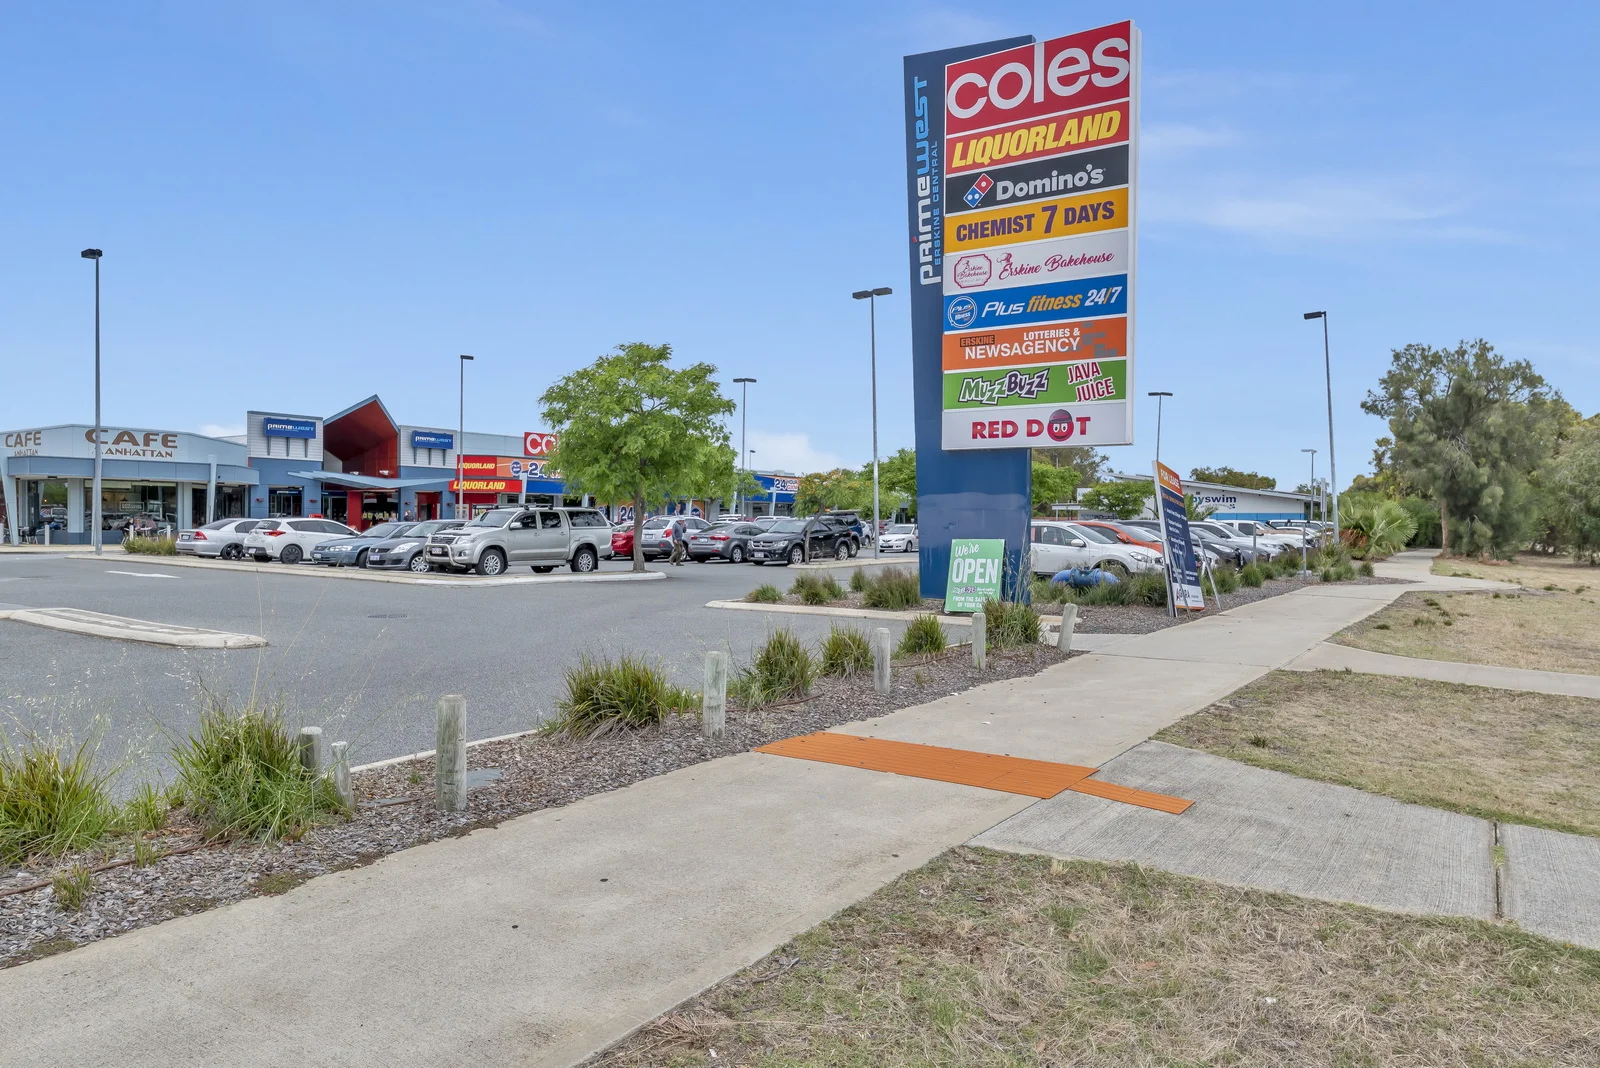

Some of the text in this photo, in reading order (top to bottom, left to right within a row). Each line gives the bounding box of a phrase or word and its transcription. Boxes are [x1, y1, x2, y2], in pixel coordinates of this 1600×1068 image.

[947, 37, 1130, 119] coles
[951, 110, 1122, 168] LIQUORLAND
[996, 163, 1105, 201] Domino's
[931, 141, 941, 266] ERSKINE CENTRAL
[956, 200, 1115, 243] CHEMIST 7 DAYS
[998, 252, 1115, 281] Erskine Bakehouse
[981, 286, 1123, 318] Plus fitness 24/7
[960, 335, 995, 347] ERSKINE
[1023, 327, 1081, 341] LOTTERIES &
[965, 337, 1081, 360] NEWSAGENCY
[1067, 361, 1102, 384] JAVA
[5, 431, 42, 448] CAFE
[84, 428, 178, 449] CAFE
[971, 420, 1019, 439] RED
[91, 446, 173, 458] ANHATTAN
[458, 462, 496, 470] LQUORLAND
[775, 478, 787, 490] 24
[954, 542, 980, 557] We're
[952, 557, 999, 584] OPEN
